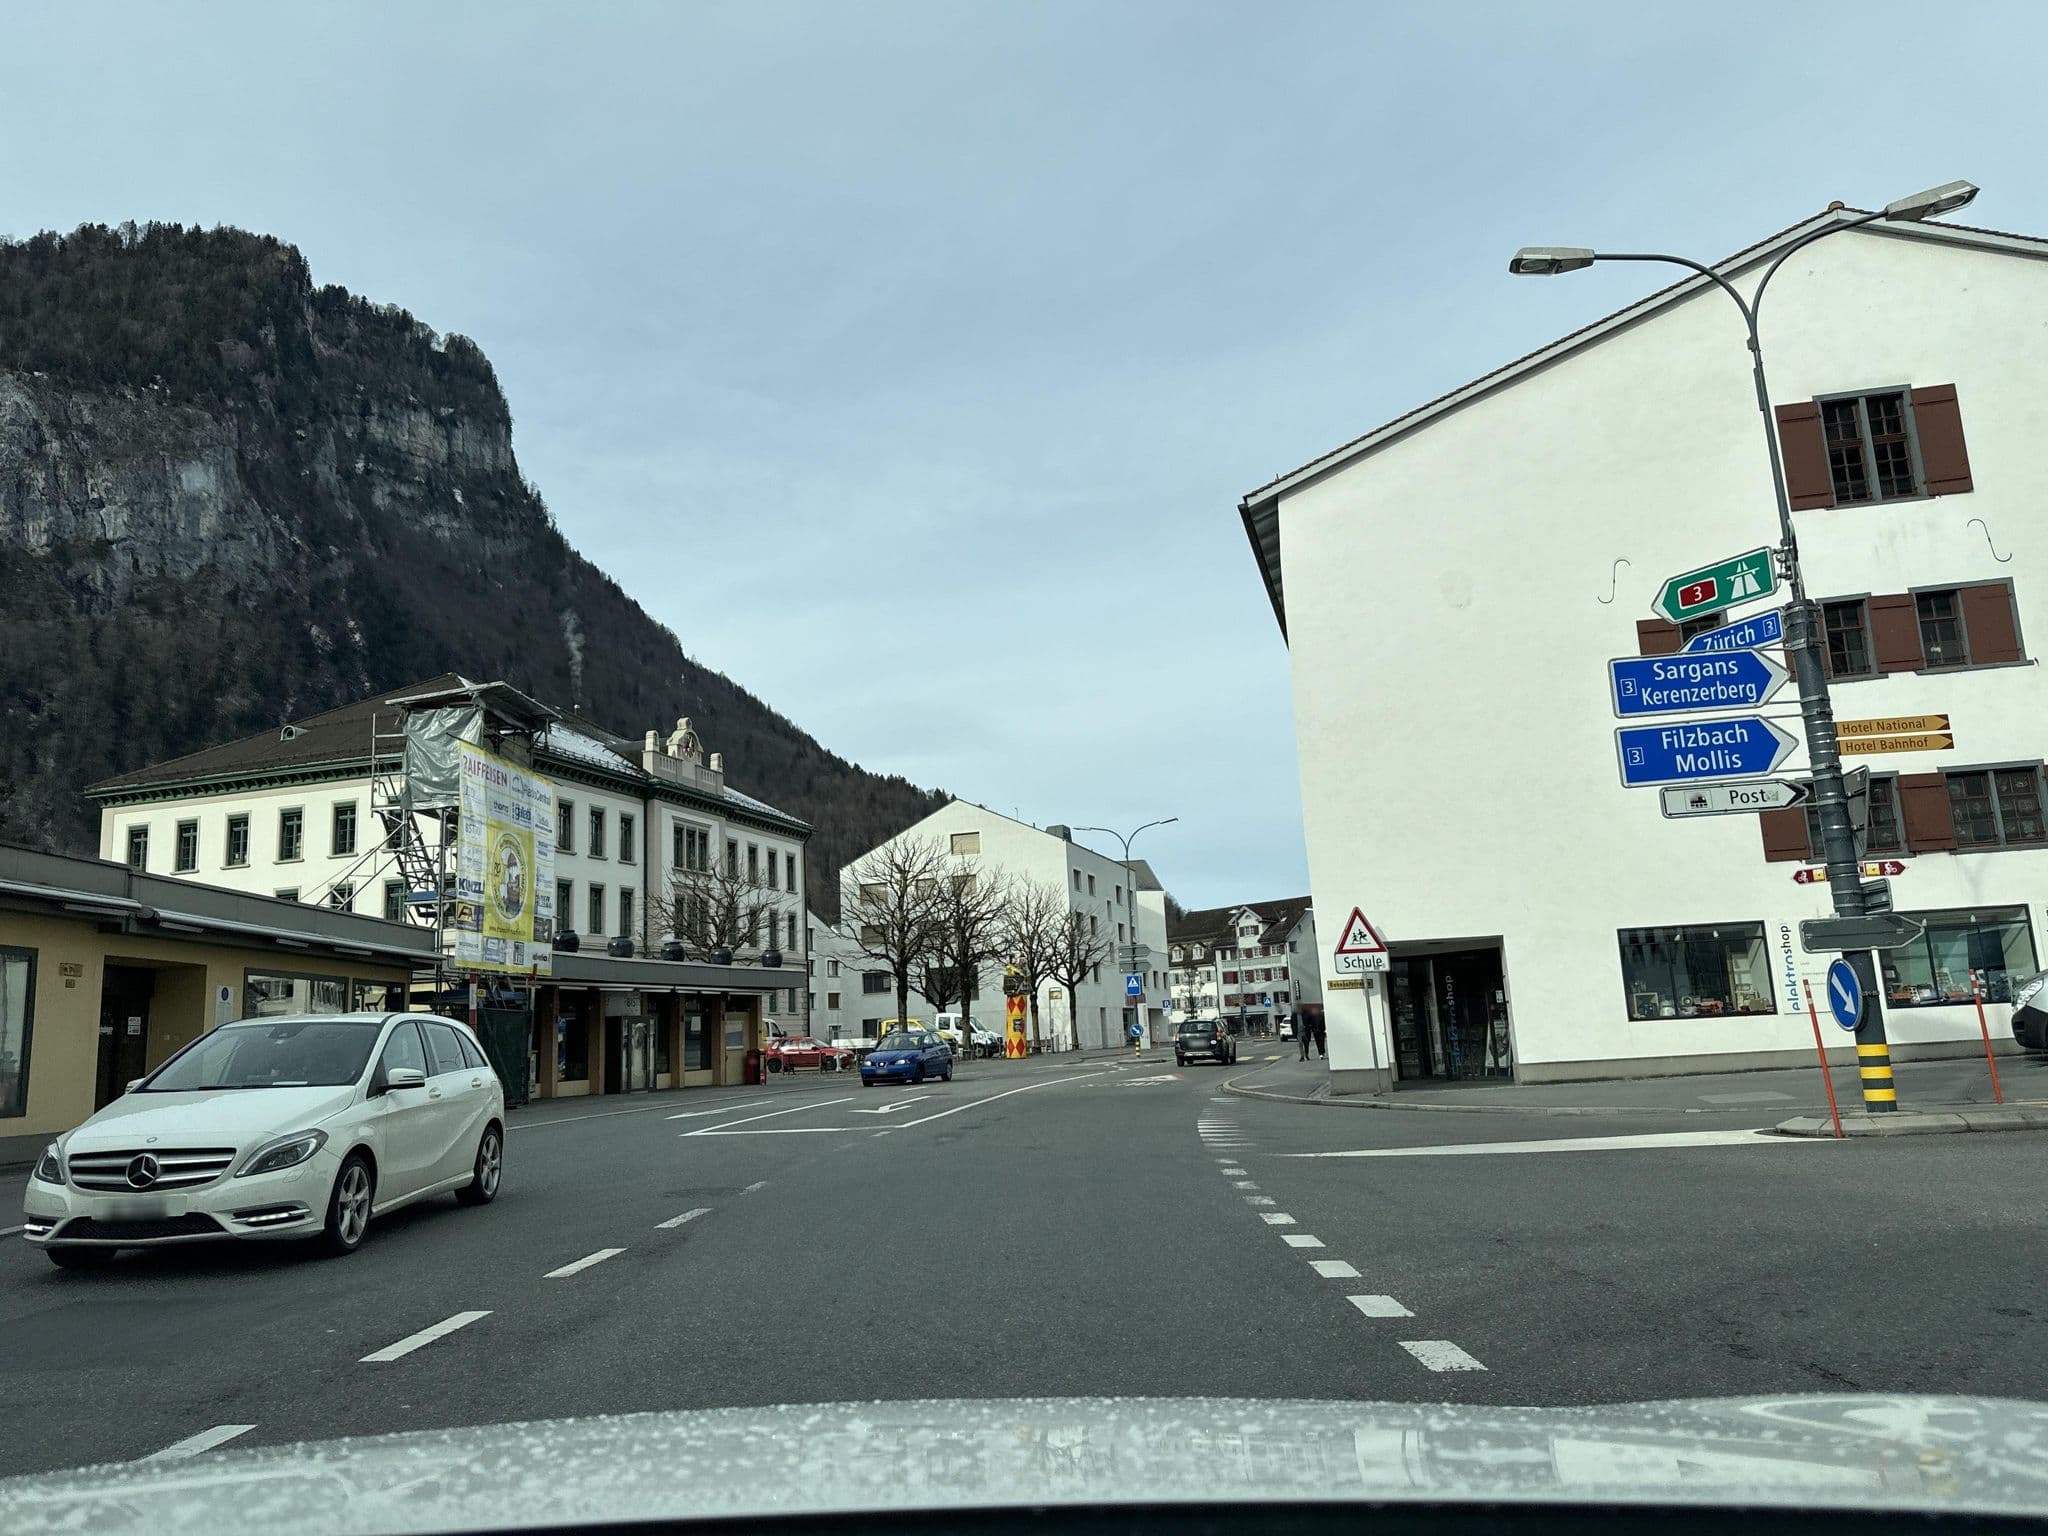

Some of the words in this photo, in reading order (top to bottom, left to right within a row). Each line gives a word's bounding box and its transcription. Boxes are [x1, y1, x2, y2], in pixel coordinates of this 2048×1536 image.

[1693, 586, 1702, 601] 3
[1703, 625, 1755, 650] Zürich
[1766, 621, 1774, 633] 3
[1653, 660, 1739, 683] Sargans
[1625, 681, 1634, 694] 3
[1641, 681, 1757, 706] Kerenzerberg
[1661, 724, 1749, 750] Filzbach
[1842, 723, 1873, 734] Hotel
[1876, 718, 1926, 731] National
[1845, 740, 1876, 752] Hotel
[1880, 737, 1929, 750] Bahnhof
[462, 755, 508, 787] RAIFFEISEN
[1632, 750, 1641, 763] 3
[1675, 750, 1742, 773] Mollis
[1729, 789, 1767, 804] Post
[1343, 955, 1383, 969] Schule
[1780, 925, 1801, 1011] elektroshop
